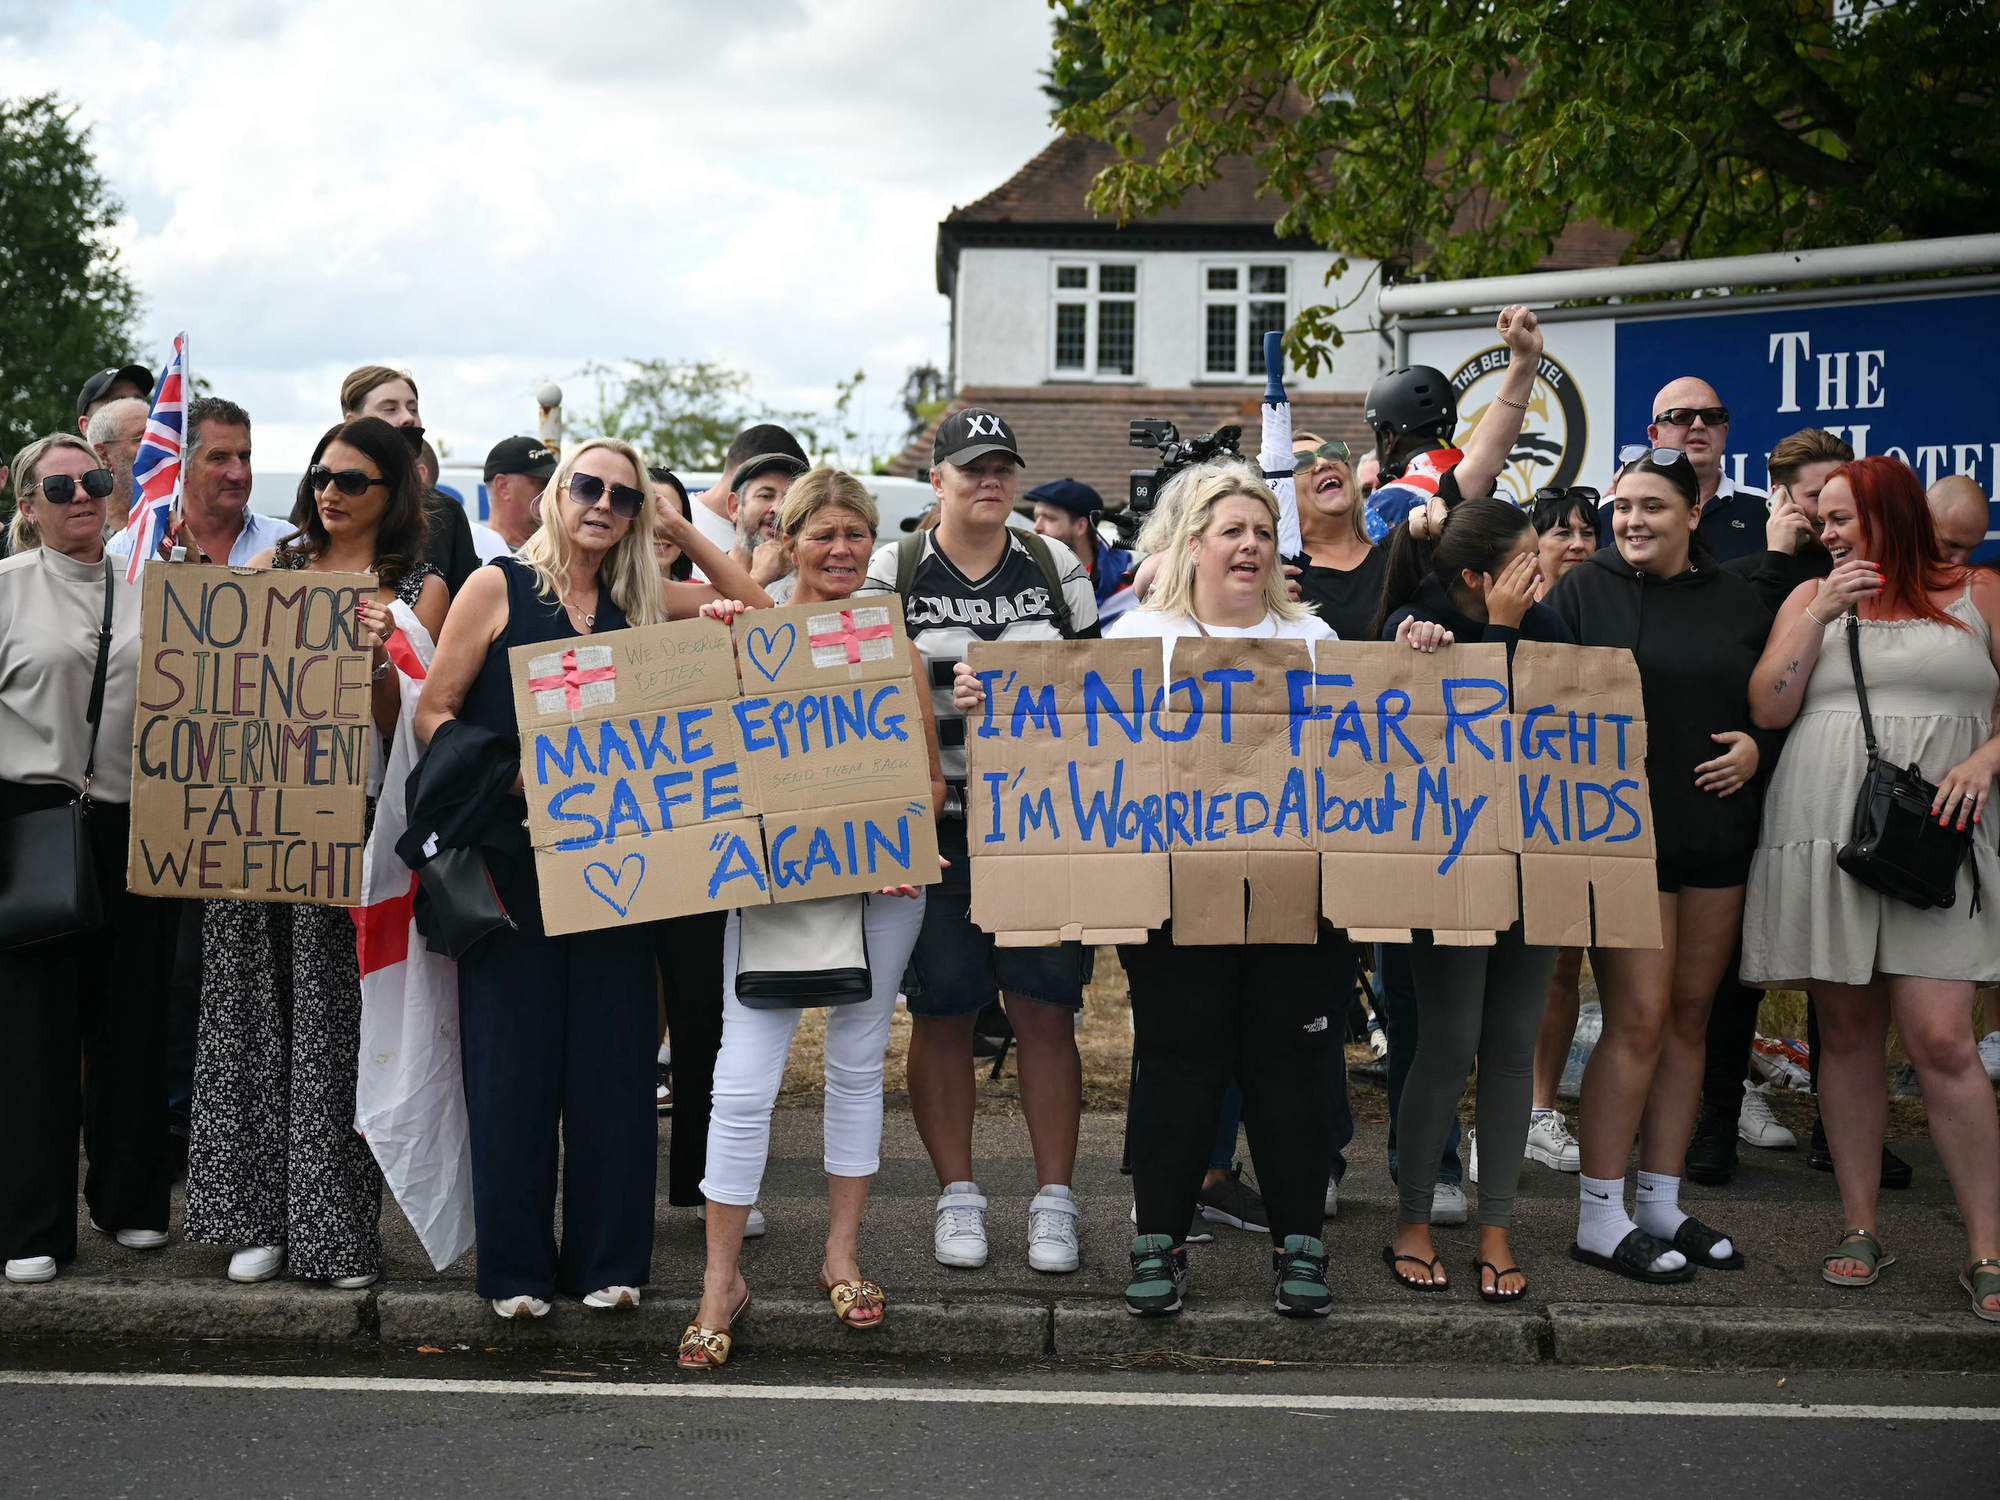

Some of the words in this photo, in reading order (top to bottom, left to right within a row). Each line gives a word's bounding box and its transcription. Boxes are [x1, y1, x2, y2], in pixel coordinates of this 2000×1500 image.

[1452, 362, 1480, 391] THE
[1481, 350, 1513, 372] BEL
[1769, 331, 1885, 413] THE
[966, 414, 1008, 439] XX
[1136, 486, 1148, 497] 99
[162, 580, 248, 648] NO
[262, 586, 379, 650] MORE
[906, 586, 1055, 626] COURAGE
[625, 643, 653, 665] WE
[635, 661, 707, 692] BETTER
[141, 650, 366, 720] SILENCE
[535, 708, 713, 786] MAKE
[732, 685, 909, 759] EPPING
[1083, 668, 1255, 747] NOT
[1285, 670, 1425, 764] FAR
[139, 715, 370, 786] GOVERNMENT
[773, 768, 814, 788] SEND
[184, 785, 301, 837] FAIL
[548, 763, 742, 852] SAFE
[1273, 766, 1407, 838] About
[1412, 766, 1488, 876] My
[1518, 773, 1642, 845] KIDS
[140, 839, 227, 888] WE
[243, 840, 362, 898] FIGHT
